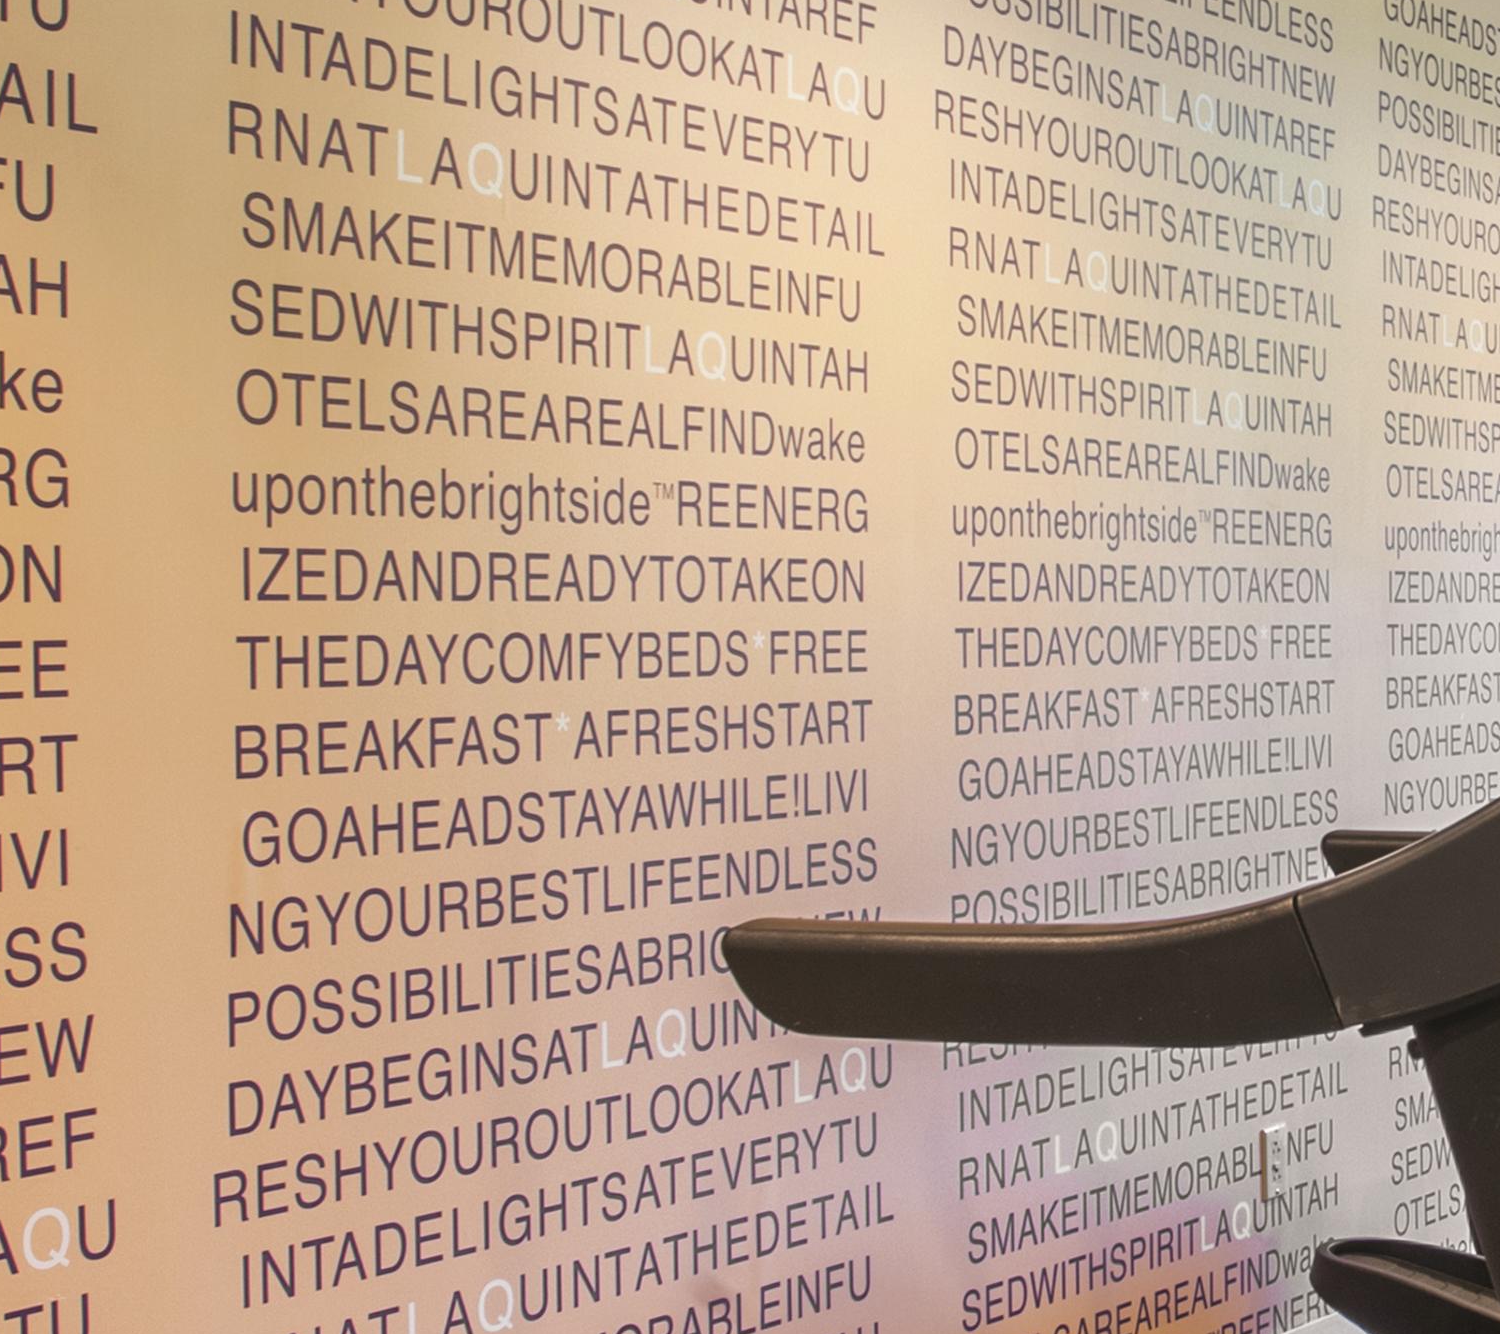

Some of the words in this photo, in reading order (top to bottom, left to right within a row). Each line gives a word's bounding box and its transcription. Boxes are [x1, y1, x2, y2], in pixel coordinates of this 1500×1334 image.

[230, 9, 869, 183] INTADELIGHTSATEVERYTU
[242, 191, 861, 323] SMAKEITMEMORABLEINFU
[236, 368, 866, 464] OTELSAREAREALFINDwake
[242, 546, 864, 604] IZEDANDREADYTOTAKEON
[242, 768, 868, 868] GOAHEADSTAYAWHILE!LIVI
[229, 836, 878, 959] NGYOURBESTLIFEENDLESS
[242, 1111, 877, 1309] INTADELIGHTSATEVERYTU
